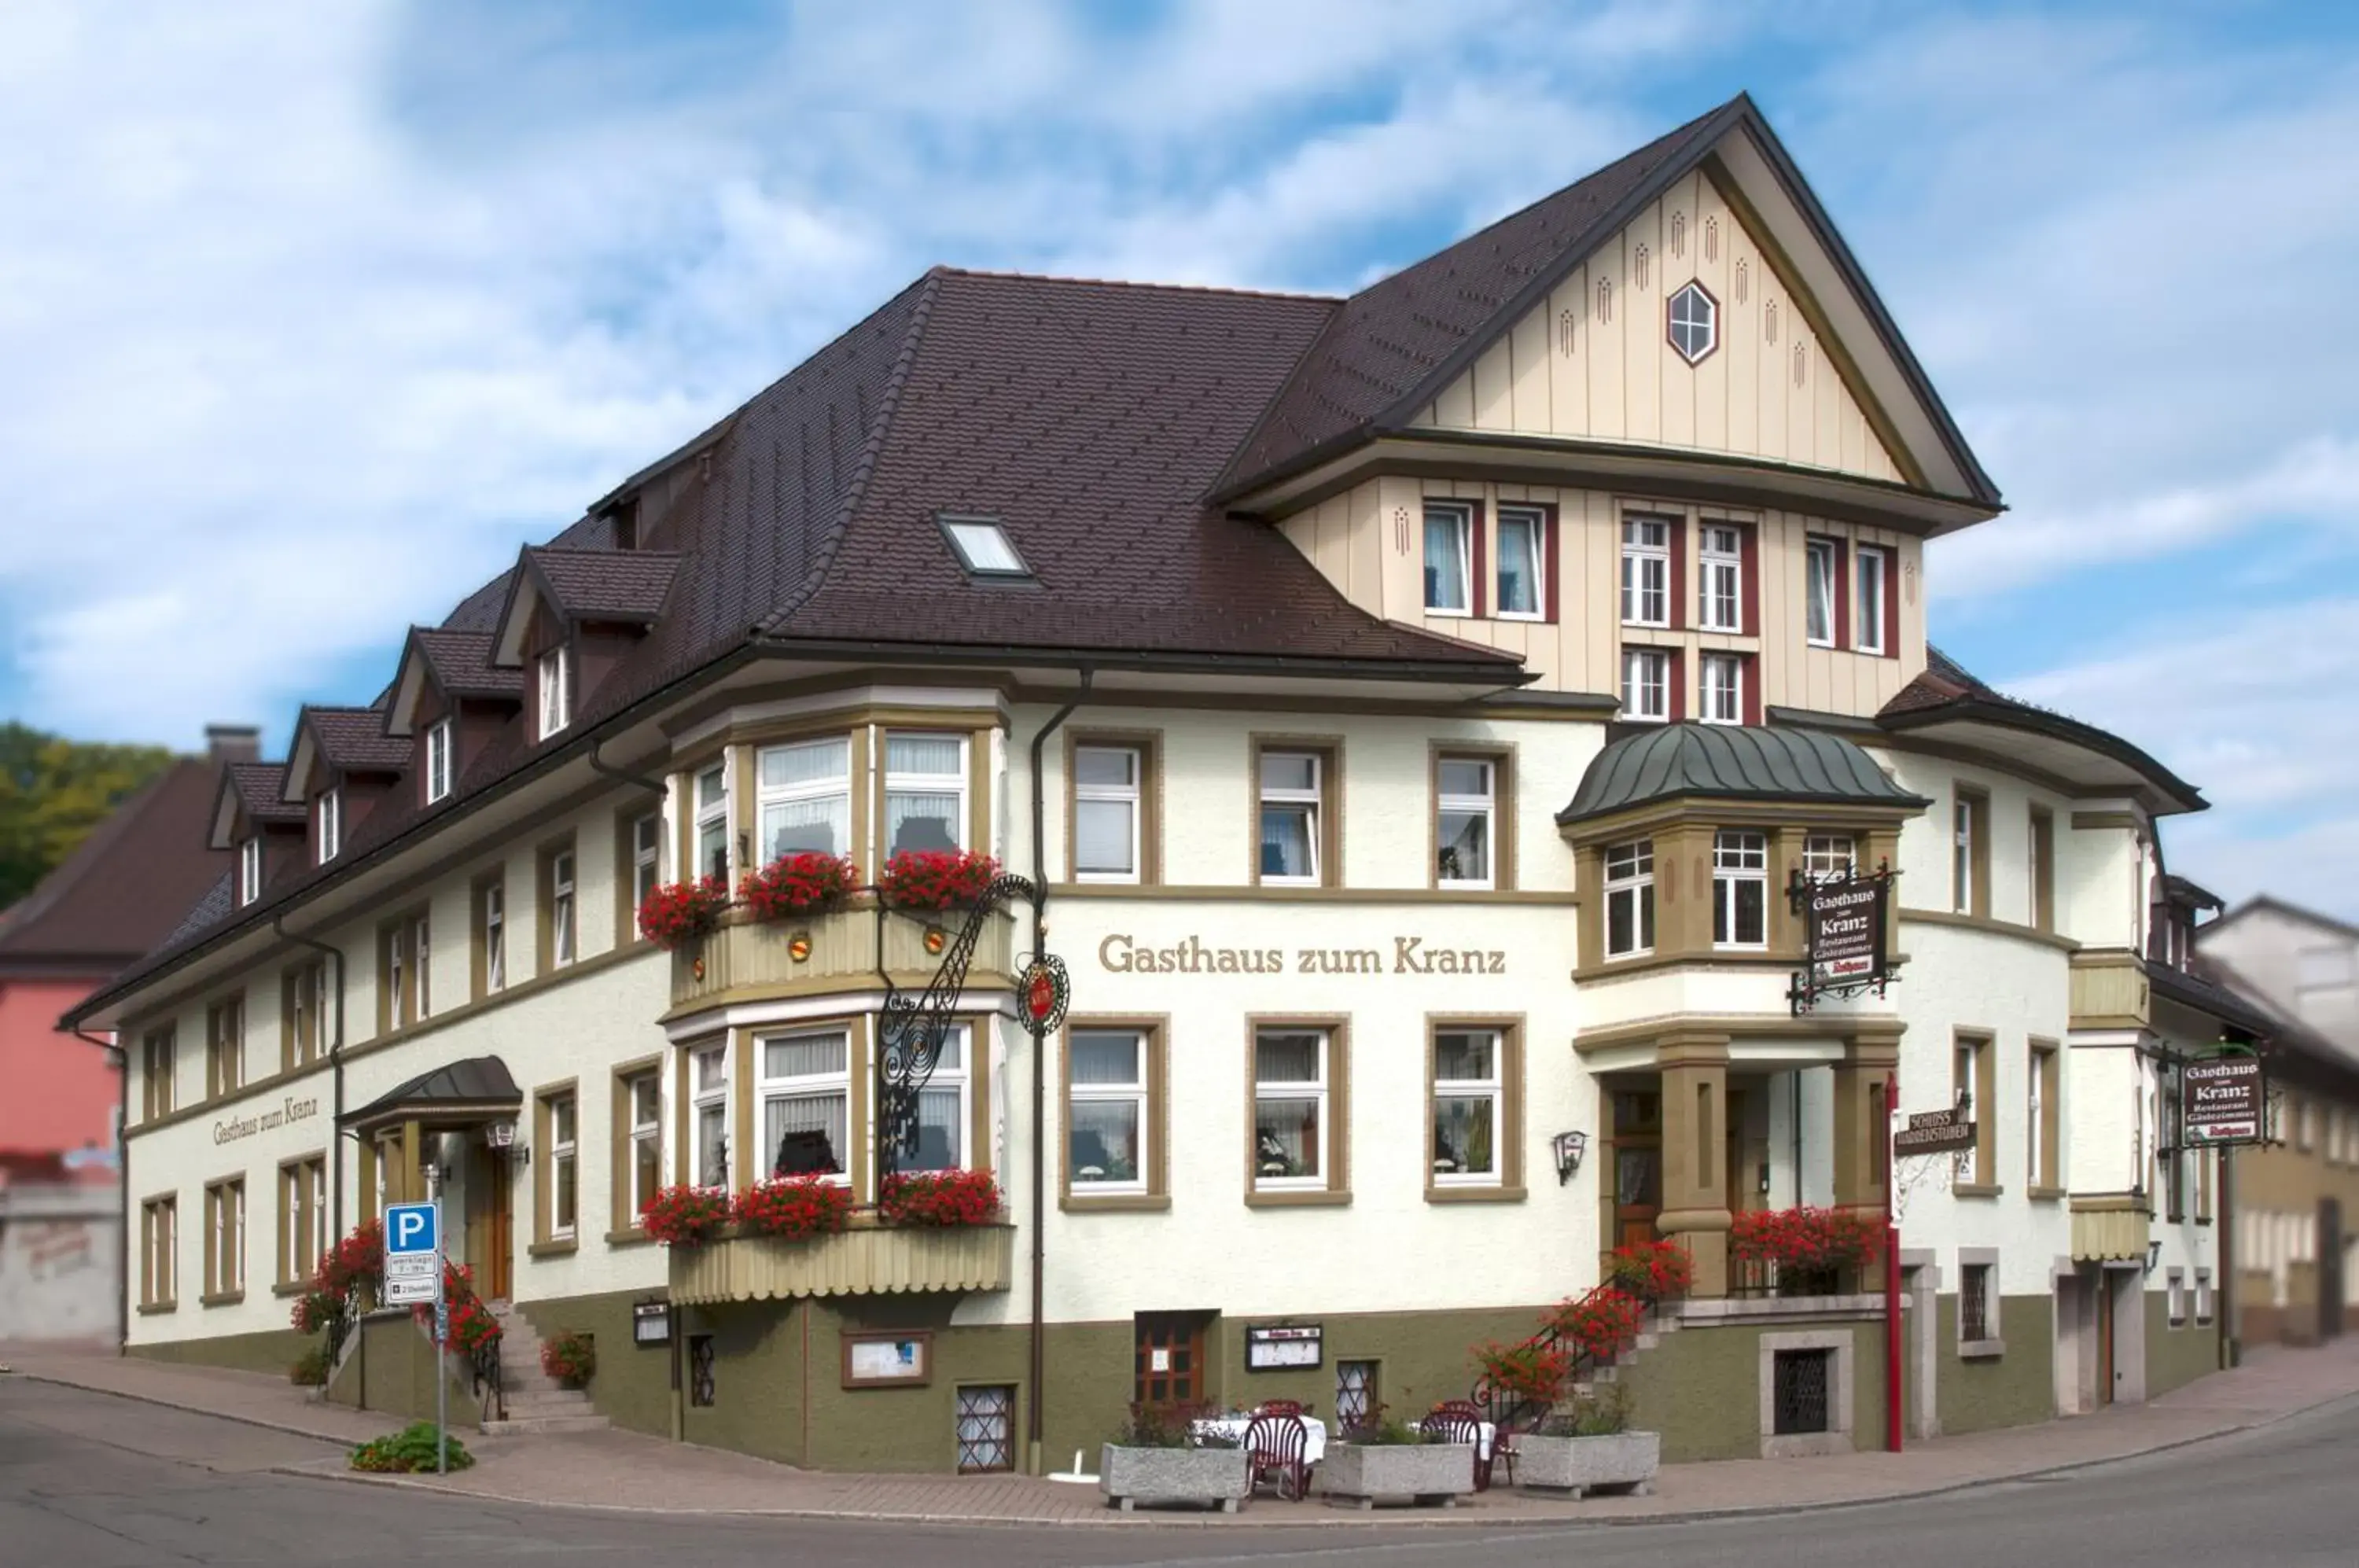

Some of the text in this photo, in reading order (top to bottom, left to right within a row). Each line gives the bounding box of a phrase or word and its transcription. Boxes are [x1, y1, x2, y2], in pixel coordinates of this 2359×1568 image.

[1812, 890, 1875, 910] Gasthaus
[1821, 916, 1868, 936] Kranz
[1819, 933, 1868, 948] Restaurant
[1098, 933, 1506, 975] Gasthaus zum Kranz
[2187, 1064, 2258, 1080] Gasthaus
[2196, 1085, 2250, 1101] Kranz
[2193, 1102, 2248, 1113] Restaurant
[213, 1097, 318, 1146] Gasthaus zum Kranz
[399, 1213, 425, 1247] P
